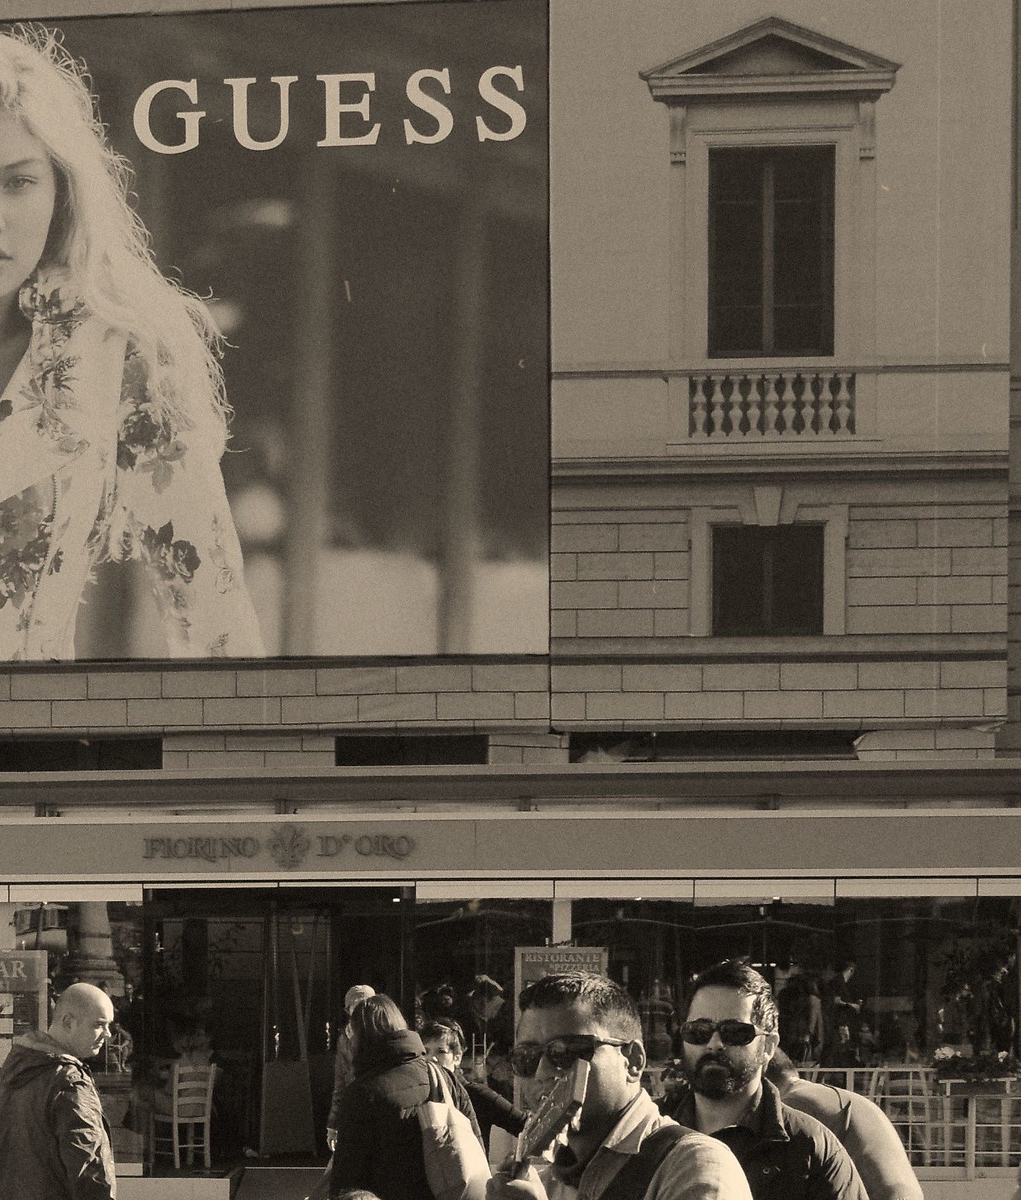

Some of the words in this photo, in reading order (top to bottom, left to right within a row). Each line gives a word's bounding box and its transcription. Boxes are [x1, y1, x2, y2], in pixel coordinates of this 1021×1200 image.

[132, 65, 528, 155] GUESS
[142, 836, 260, 863] FIORINO
[316, 834, 415, 860] D'ORO
[525, 953, 600, 962] RISTORANTE
